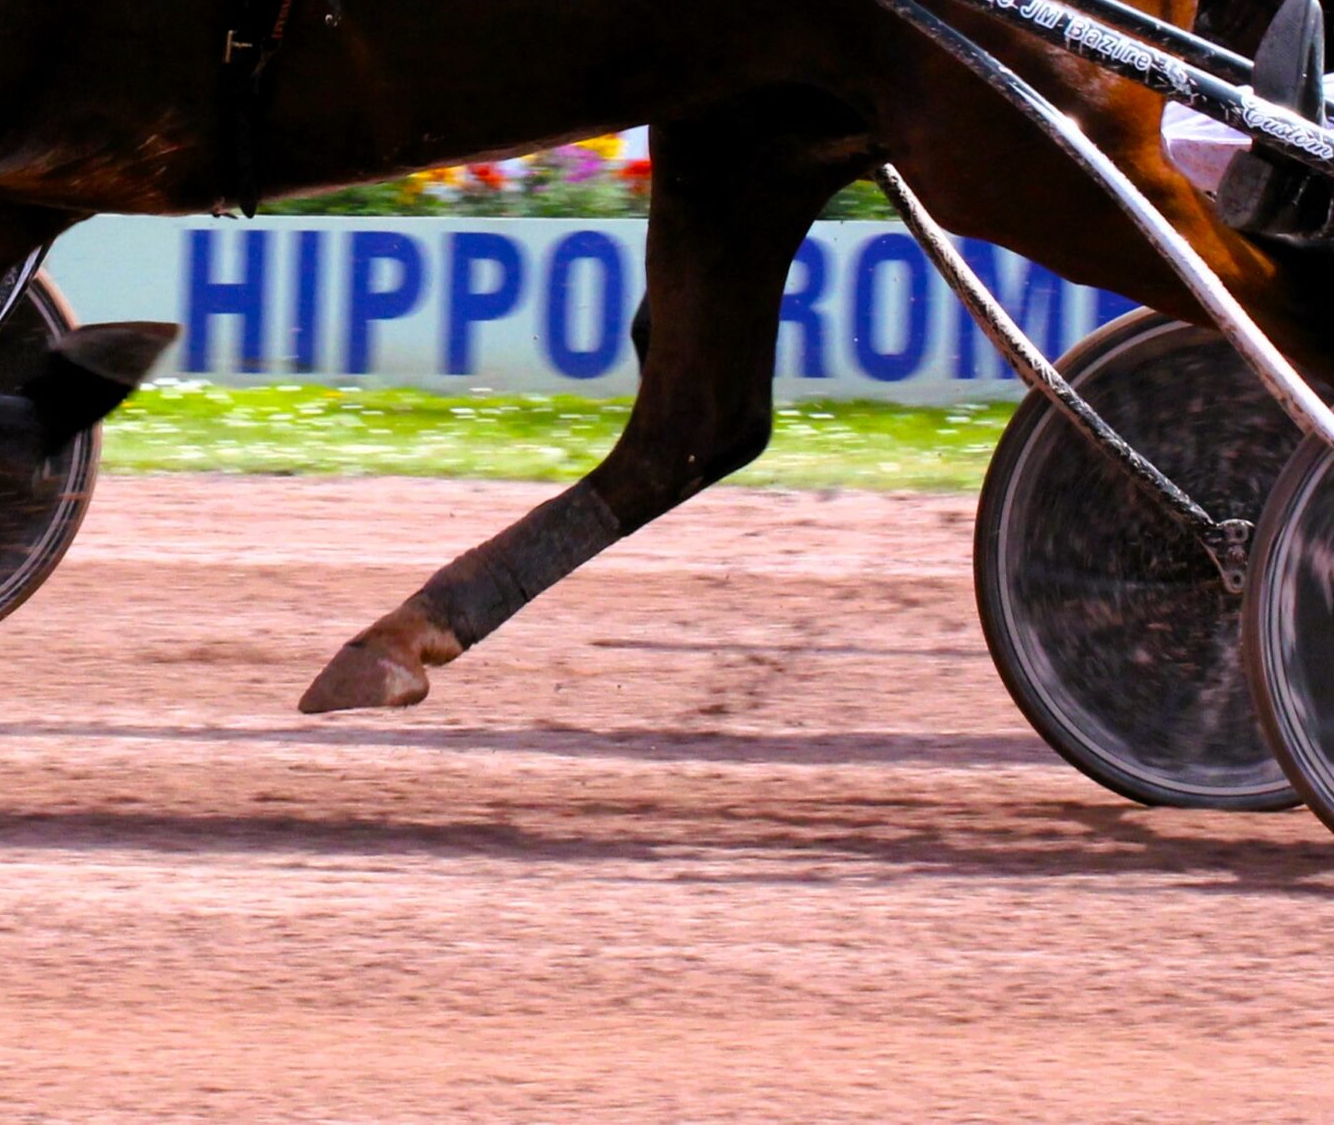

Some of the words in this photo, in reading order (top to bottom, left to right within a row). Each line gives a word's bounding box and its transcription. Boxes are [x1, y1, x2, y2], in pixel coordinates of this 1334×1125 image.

[1064, 13, 1153, 71] Bazire
[1241, 94, 1334, 161] Custom
[182, 227, 1141, 382] HIPPOROM
